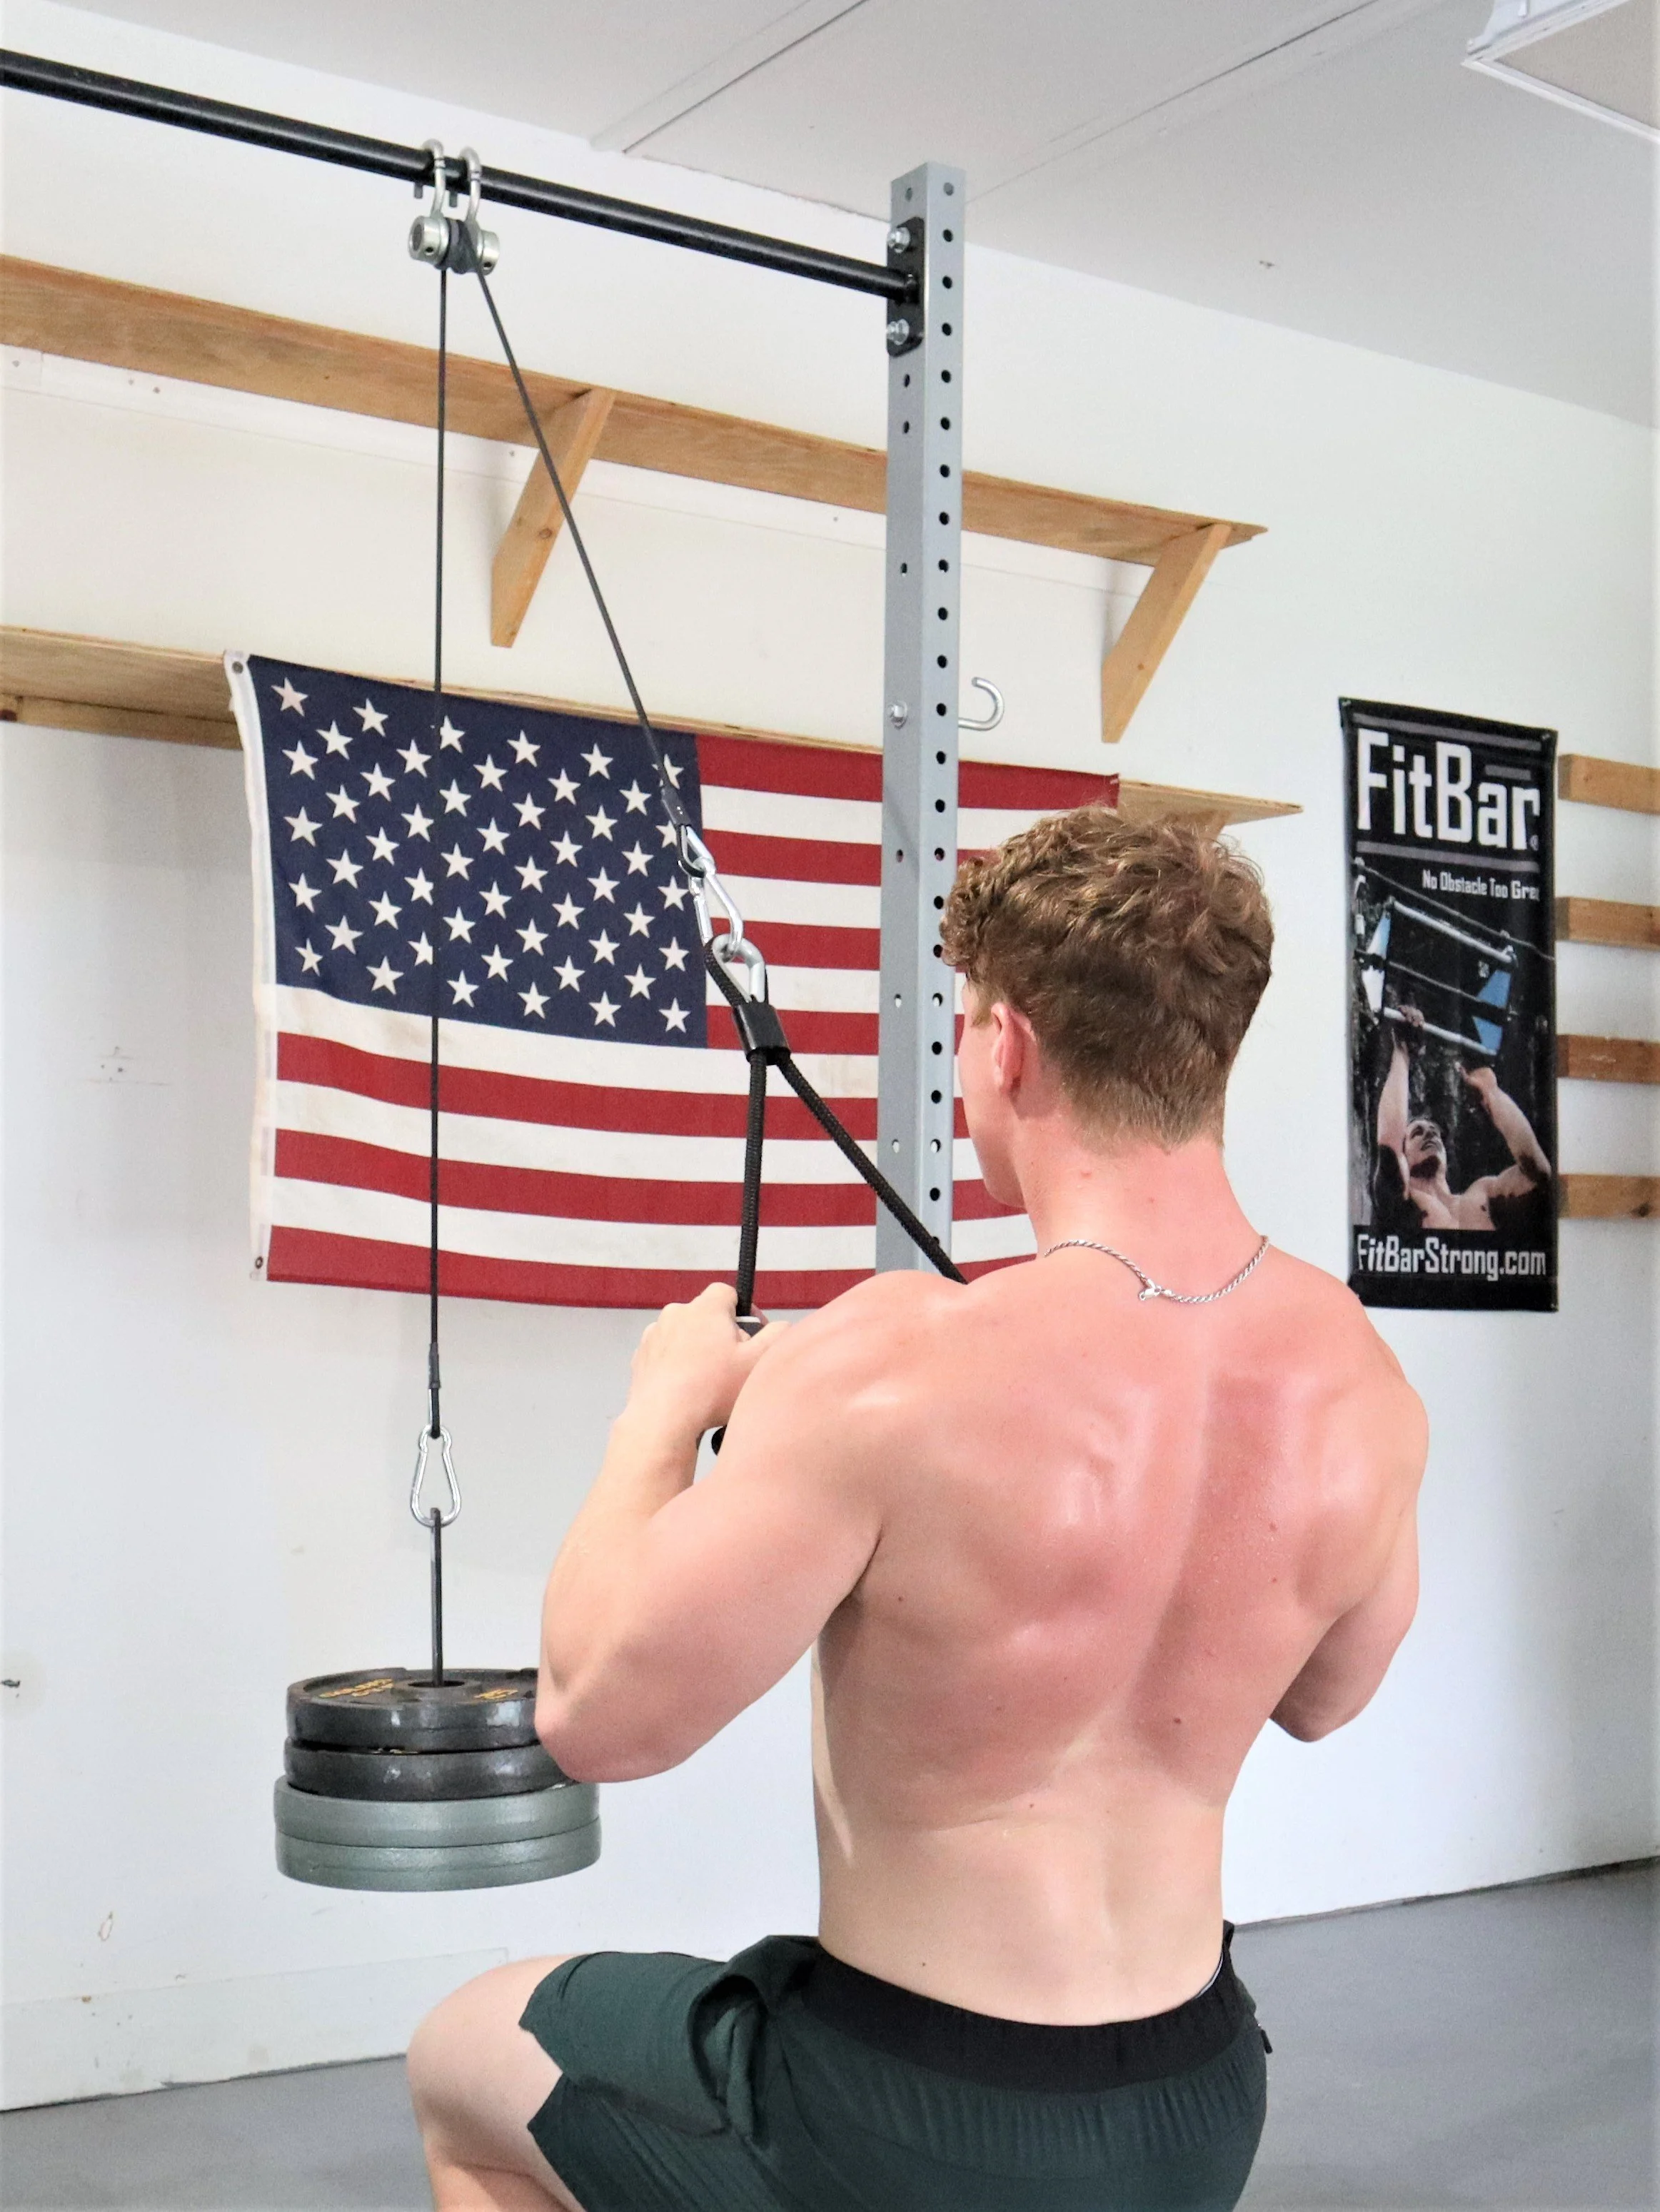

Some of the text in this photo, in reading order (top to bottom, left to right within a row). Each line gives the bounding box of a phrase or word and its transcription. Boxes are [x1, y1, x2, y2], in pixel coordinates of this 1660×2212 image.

[1357, 728, 1540, 850] FitBar
[1422, 869, 1437, 889] No
[1439, 871, 1487, 895] Obstacle
[1489, 877, 1509, 899] Too
[1357, 1234, 1546, 1281] FitBarStrong.com
